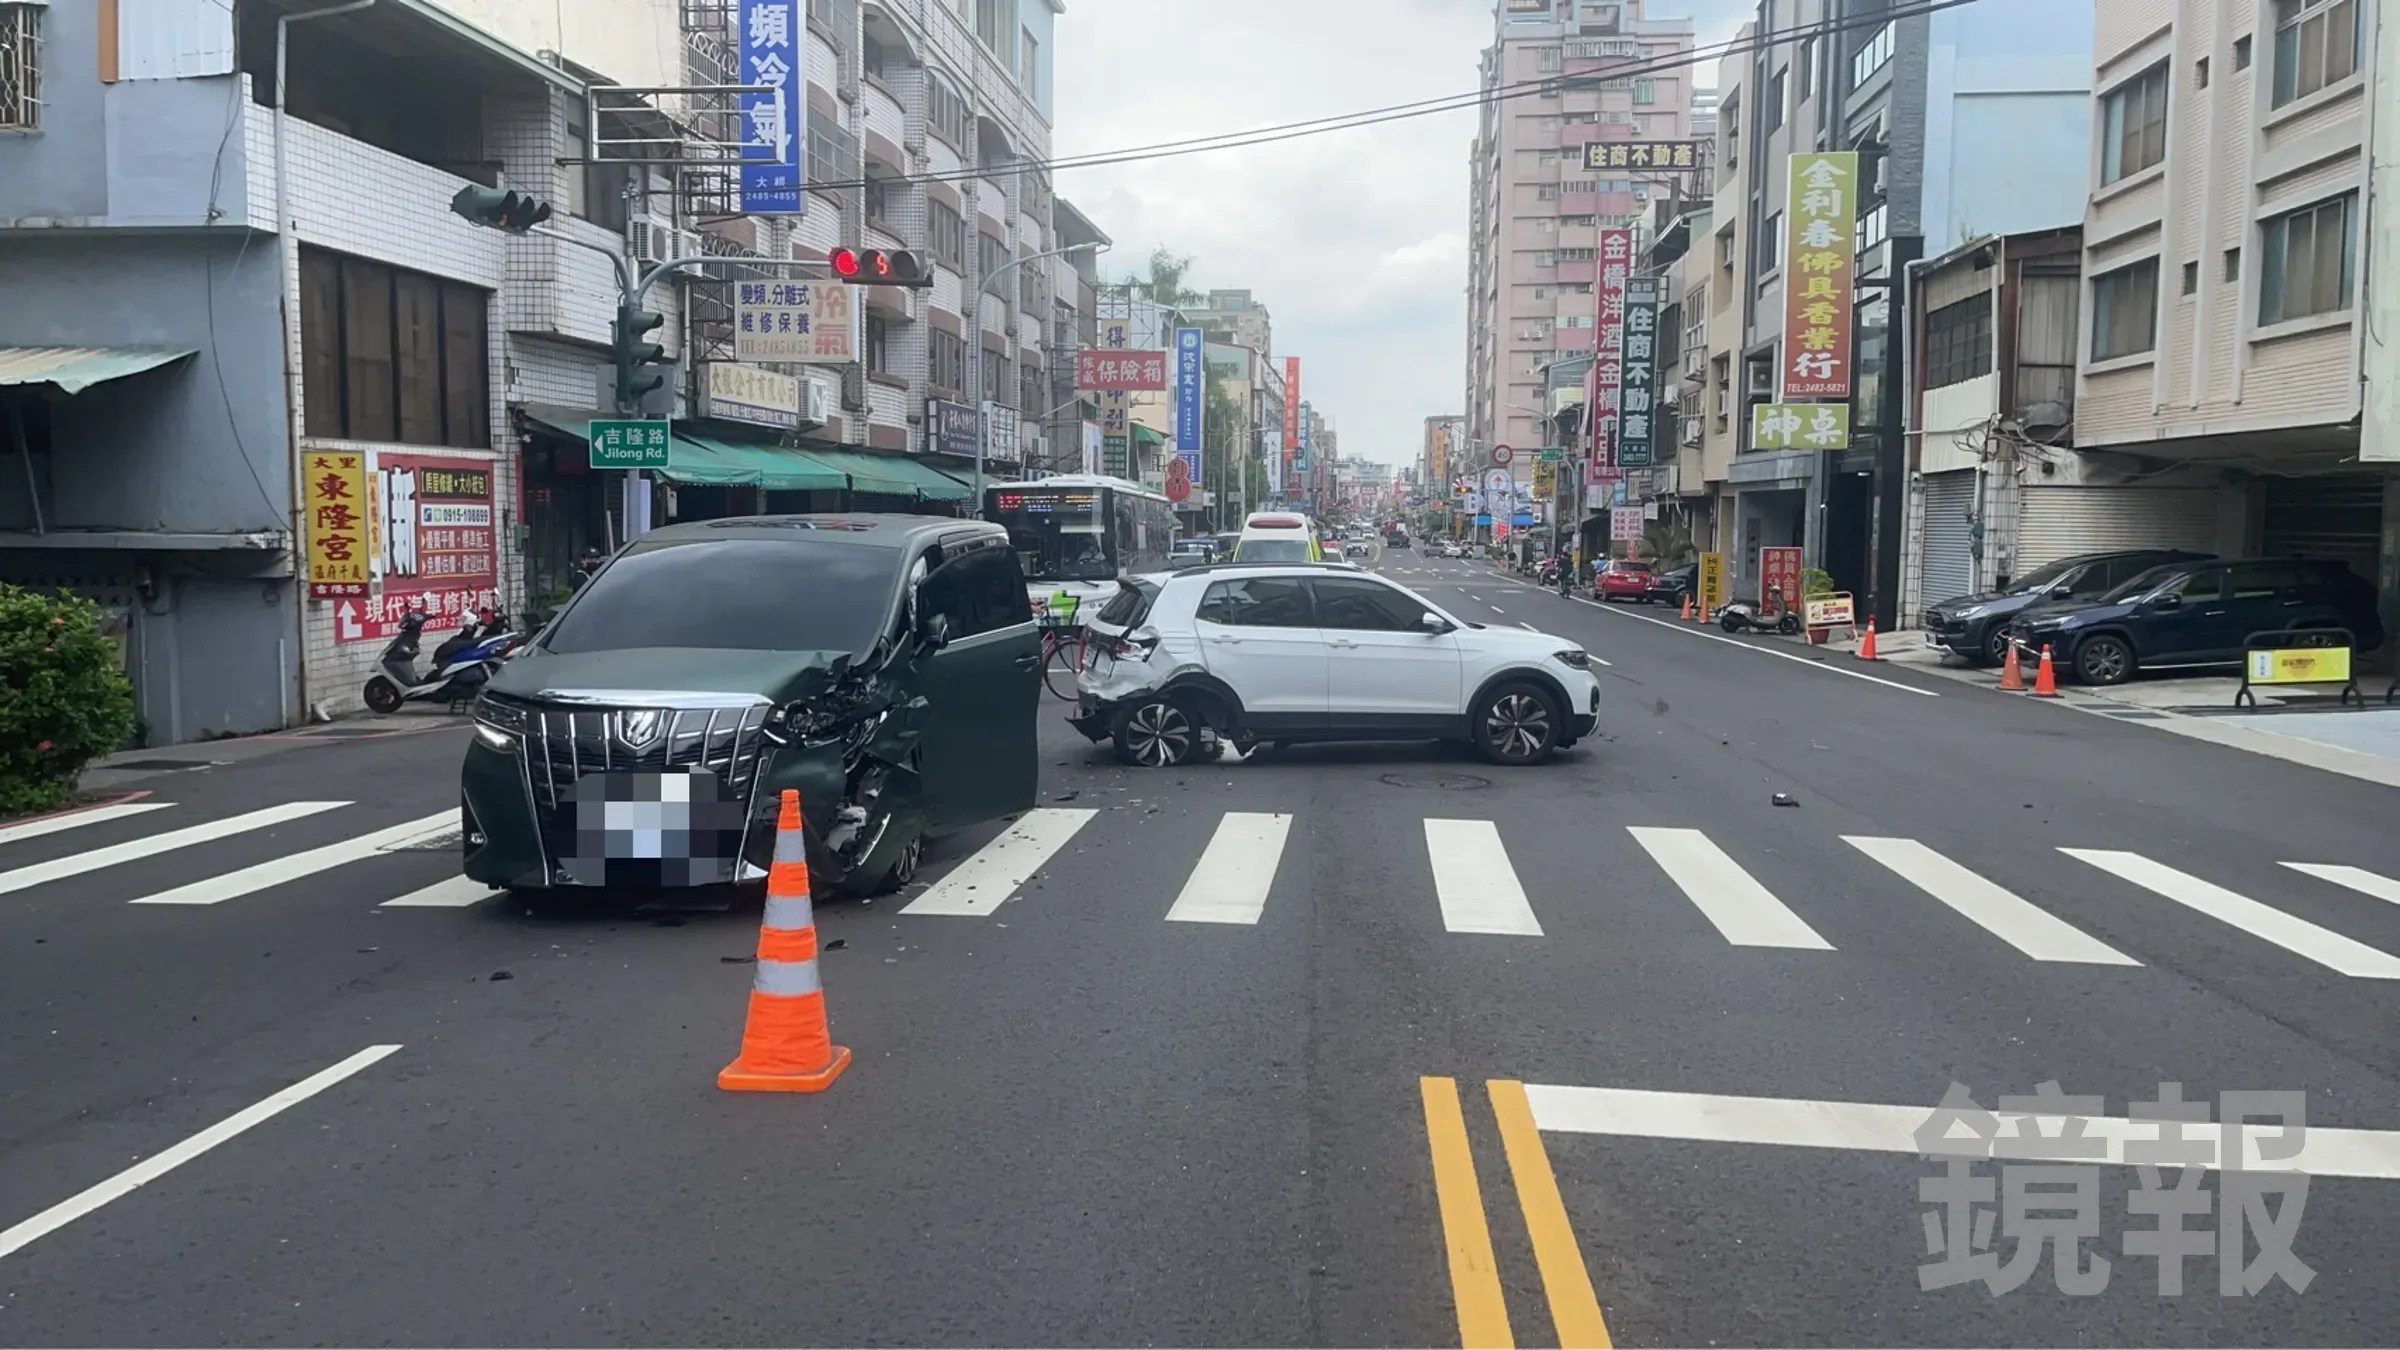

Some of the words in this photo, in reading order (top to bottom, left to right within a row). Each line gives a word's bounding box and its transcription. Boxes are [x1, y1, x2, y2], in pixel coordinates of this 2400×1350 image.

[1589, 144, 1692, 166] 住商不動產
[1793, 159, 1847, 379] 金利春佛具香業行
[741, 312, 810, 334] 維修保養
[813, 286, 849, 355] 冷氣
[1097, 360, 1161, 382] 保險箱
[1624, 307, 1653, 438] 住商不動產
[604, 428, 664, 445] 吉隆路
[1760, 408, 1844, 445] 神桌
[313, 457, 357, 469] 大里
[604, 448, 643, 460] Jilong
[646, 448, 665, 458] Rd.
[315, 473, 361, 561] 東隆宮
[443, 508, 488, 522] 0915-108899
[315, 585, 362, 594] 吉隆路
